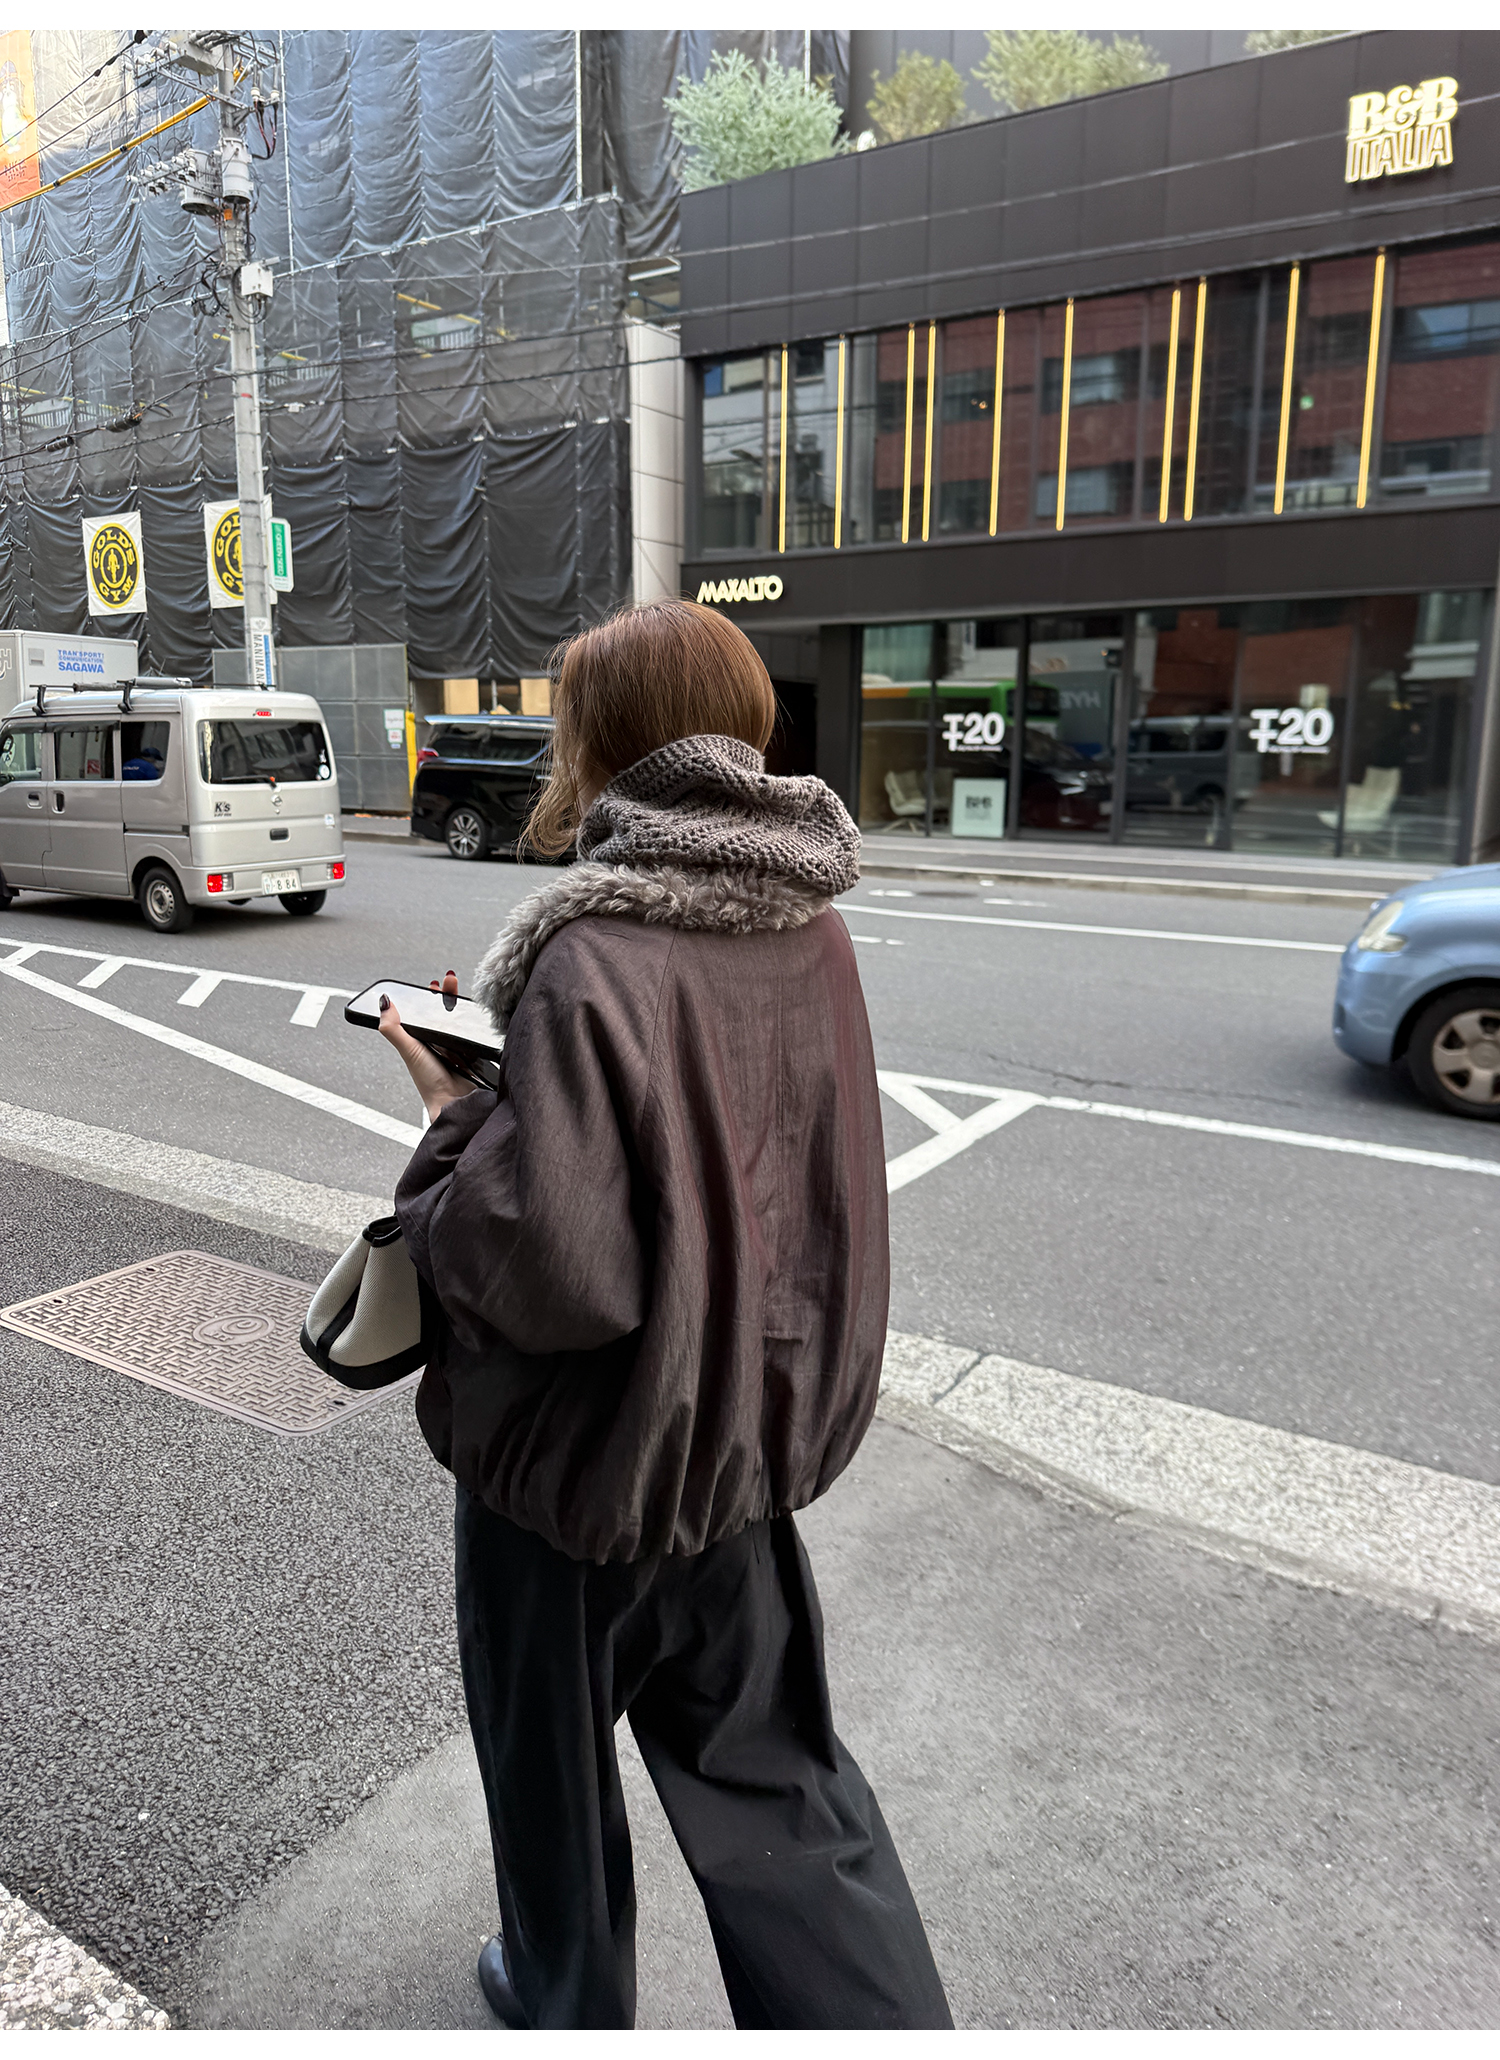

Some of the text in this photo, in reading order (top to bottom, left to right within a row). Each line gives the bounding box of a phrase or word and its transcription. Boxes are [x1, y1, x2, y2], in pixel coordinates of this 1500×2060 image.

[1346, 76, 1458, 141] B&B
[1345, 121, 1453, 183] ITALIA
[98, 574, 134, 602] GYM
[696, 574, 784, 604] MAXALTO
[58, 661, 105, 674] SAGAWA
